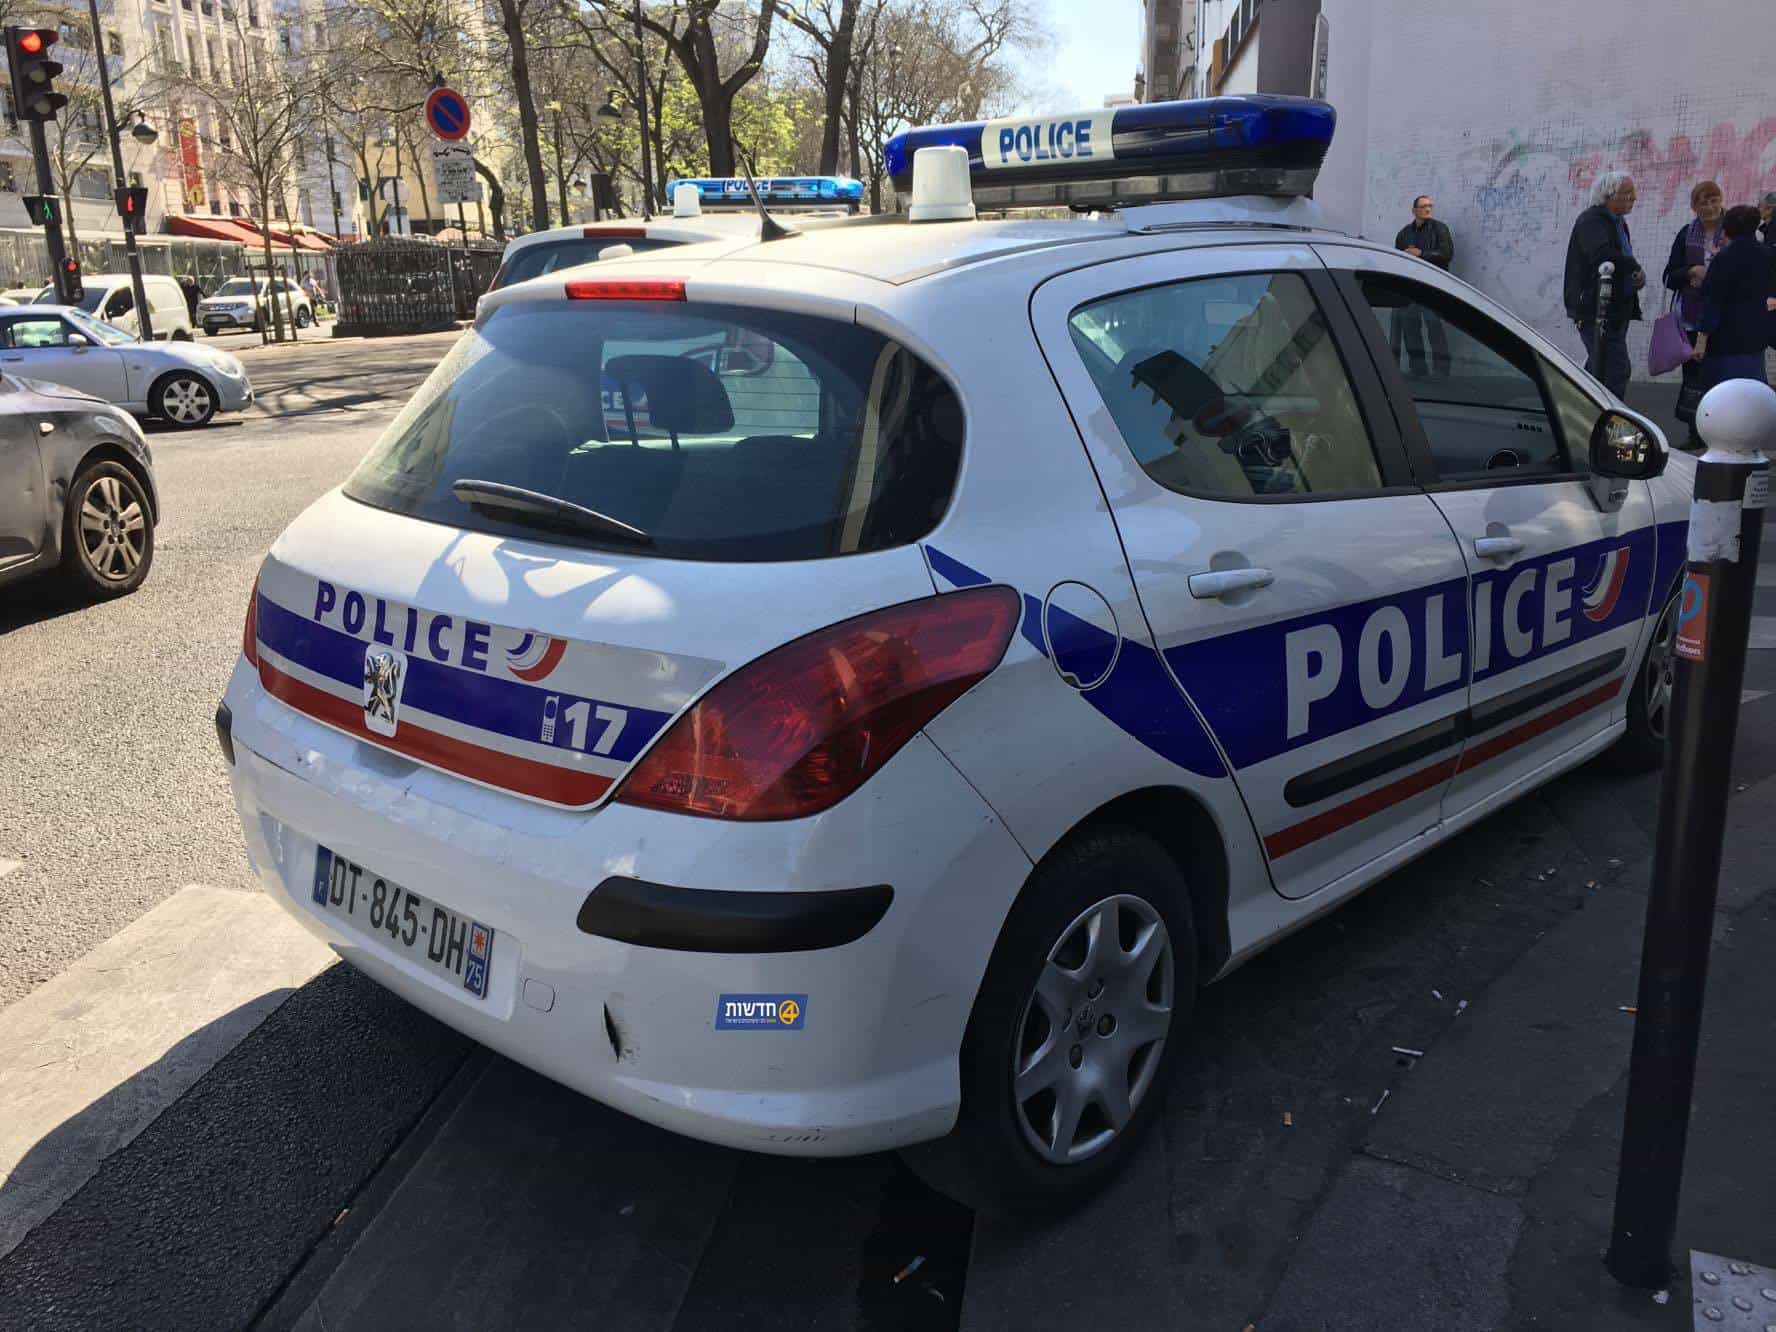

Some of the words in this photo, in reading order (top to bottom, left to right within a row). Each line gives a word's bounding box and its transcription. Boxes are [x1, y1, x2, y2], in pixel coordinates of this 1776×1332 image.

[1000, 120, 1092, 163] POLICE
[726, 179, 769, 191] POLCE
[313, 580, 491, 671] POLICE
[1285, 557, 1576, 739] POLICE
[564, 700, 628, 755] 17
[329, 855, 467, 975] DT-845-DH
[466, 960, 484, 989] 75
